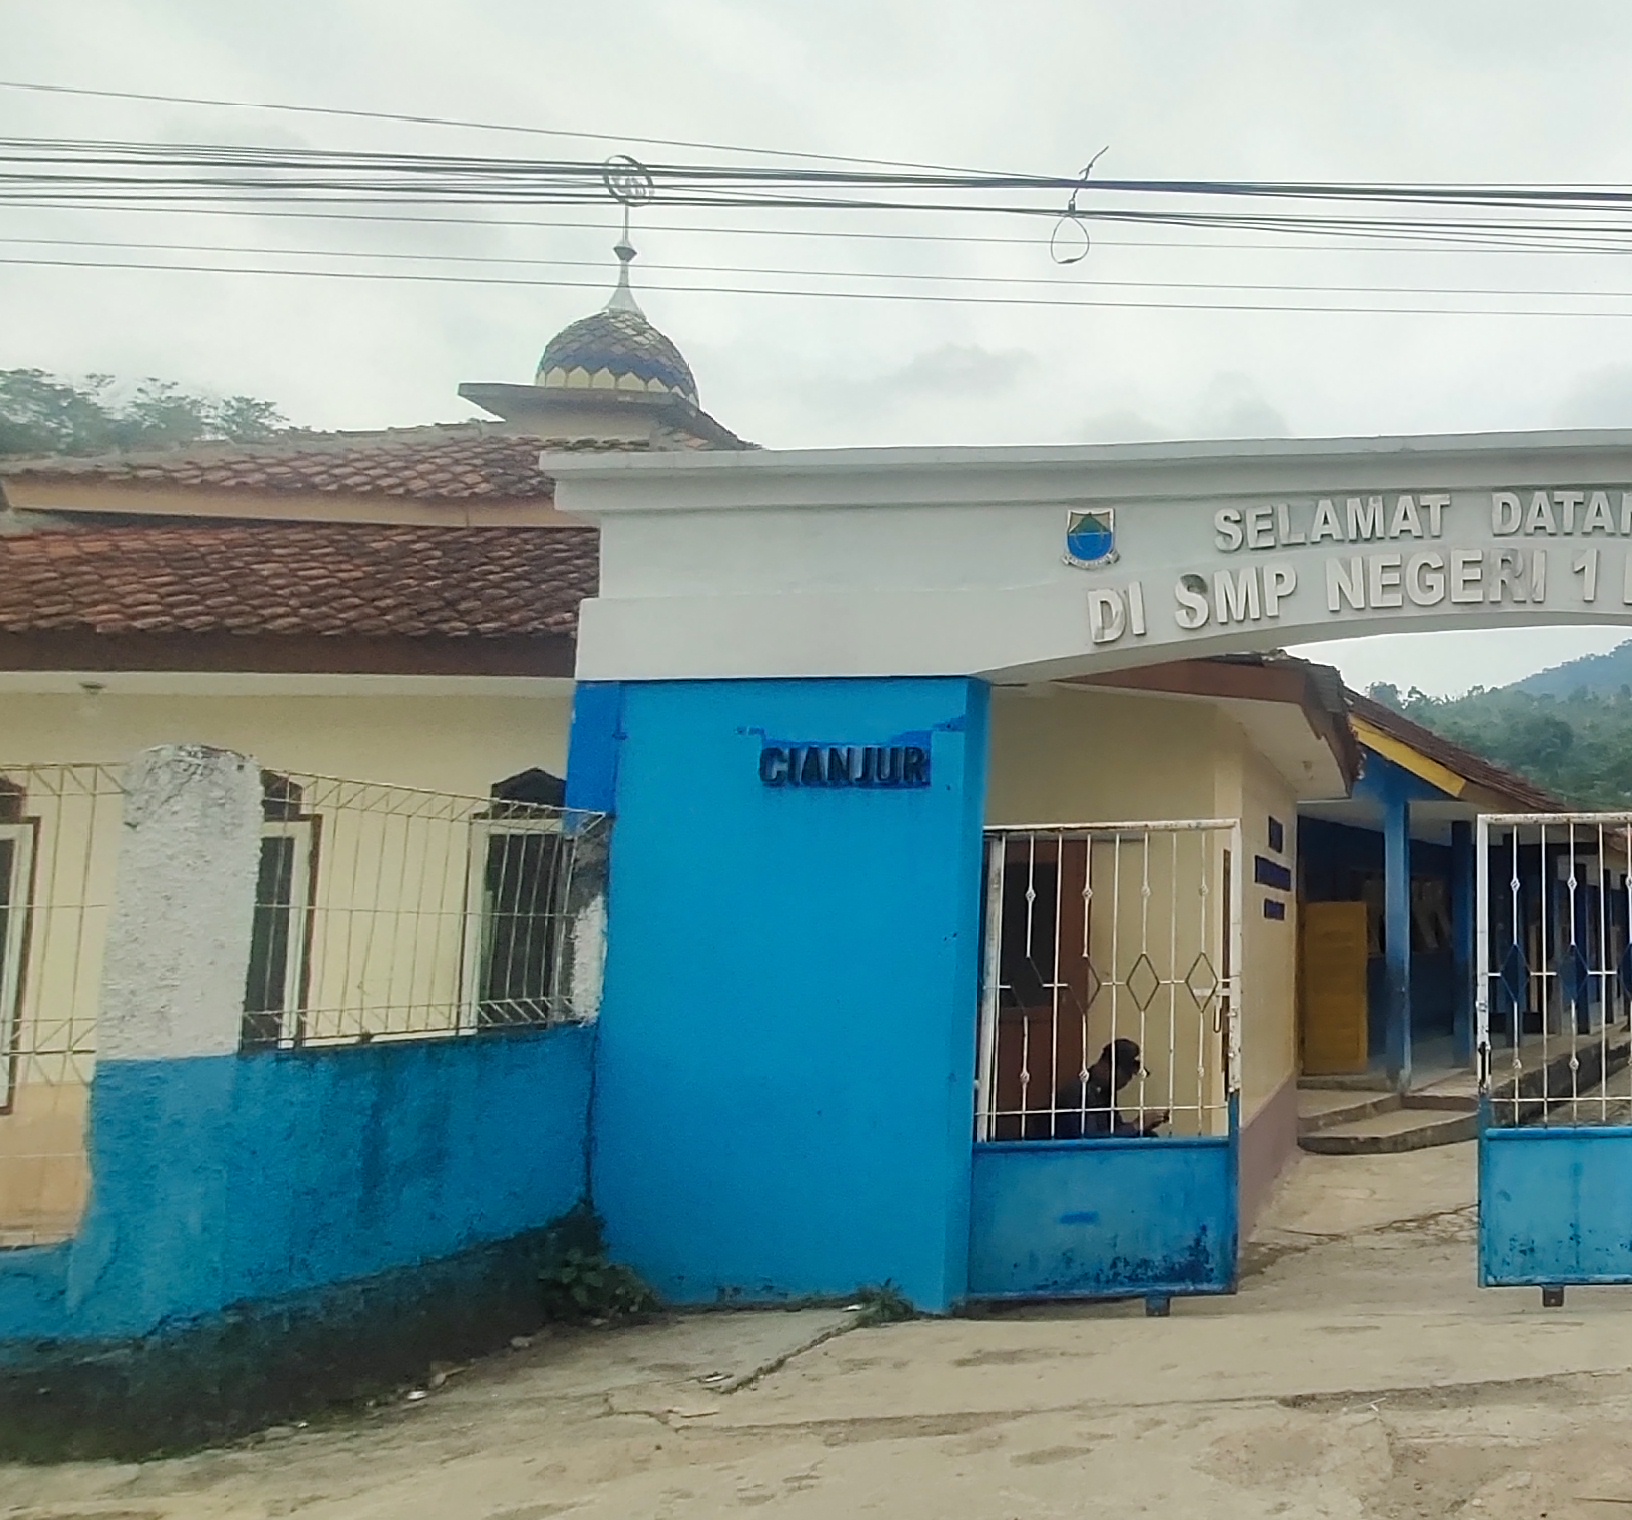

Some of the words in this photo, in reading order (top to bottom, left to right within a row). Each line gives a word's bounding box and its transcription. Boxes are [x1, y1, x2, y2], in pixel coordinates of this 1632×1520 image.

[1213, 492, 1452, 552] SELAMAT
[1087, 581, 1147, 643] DI
[1174, 564, 1298, 631] SMP
[1327, 549, 1548, 612] NEGERI
[1572, 549, 1599, 602] 1
[759, 746, 929, 787] CIANJUR
